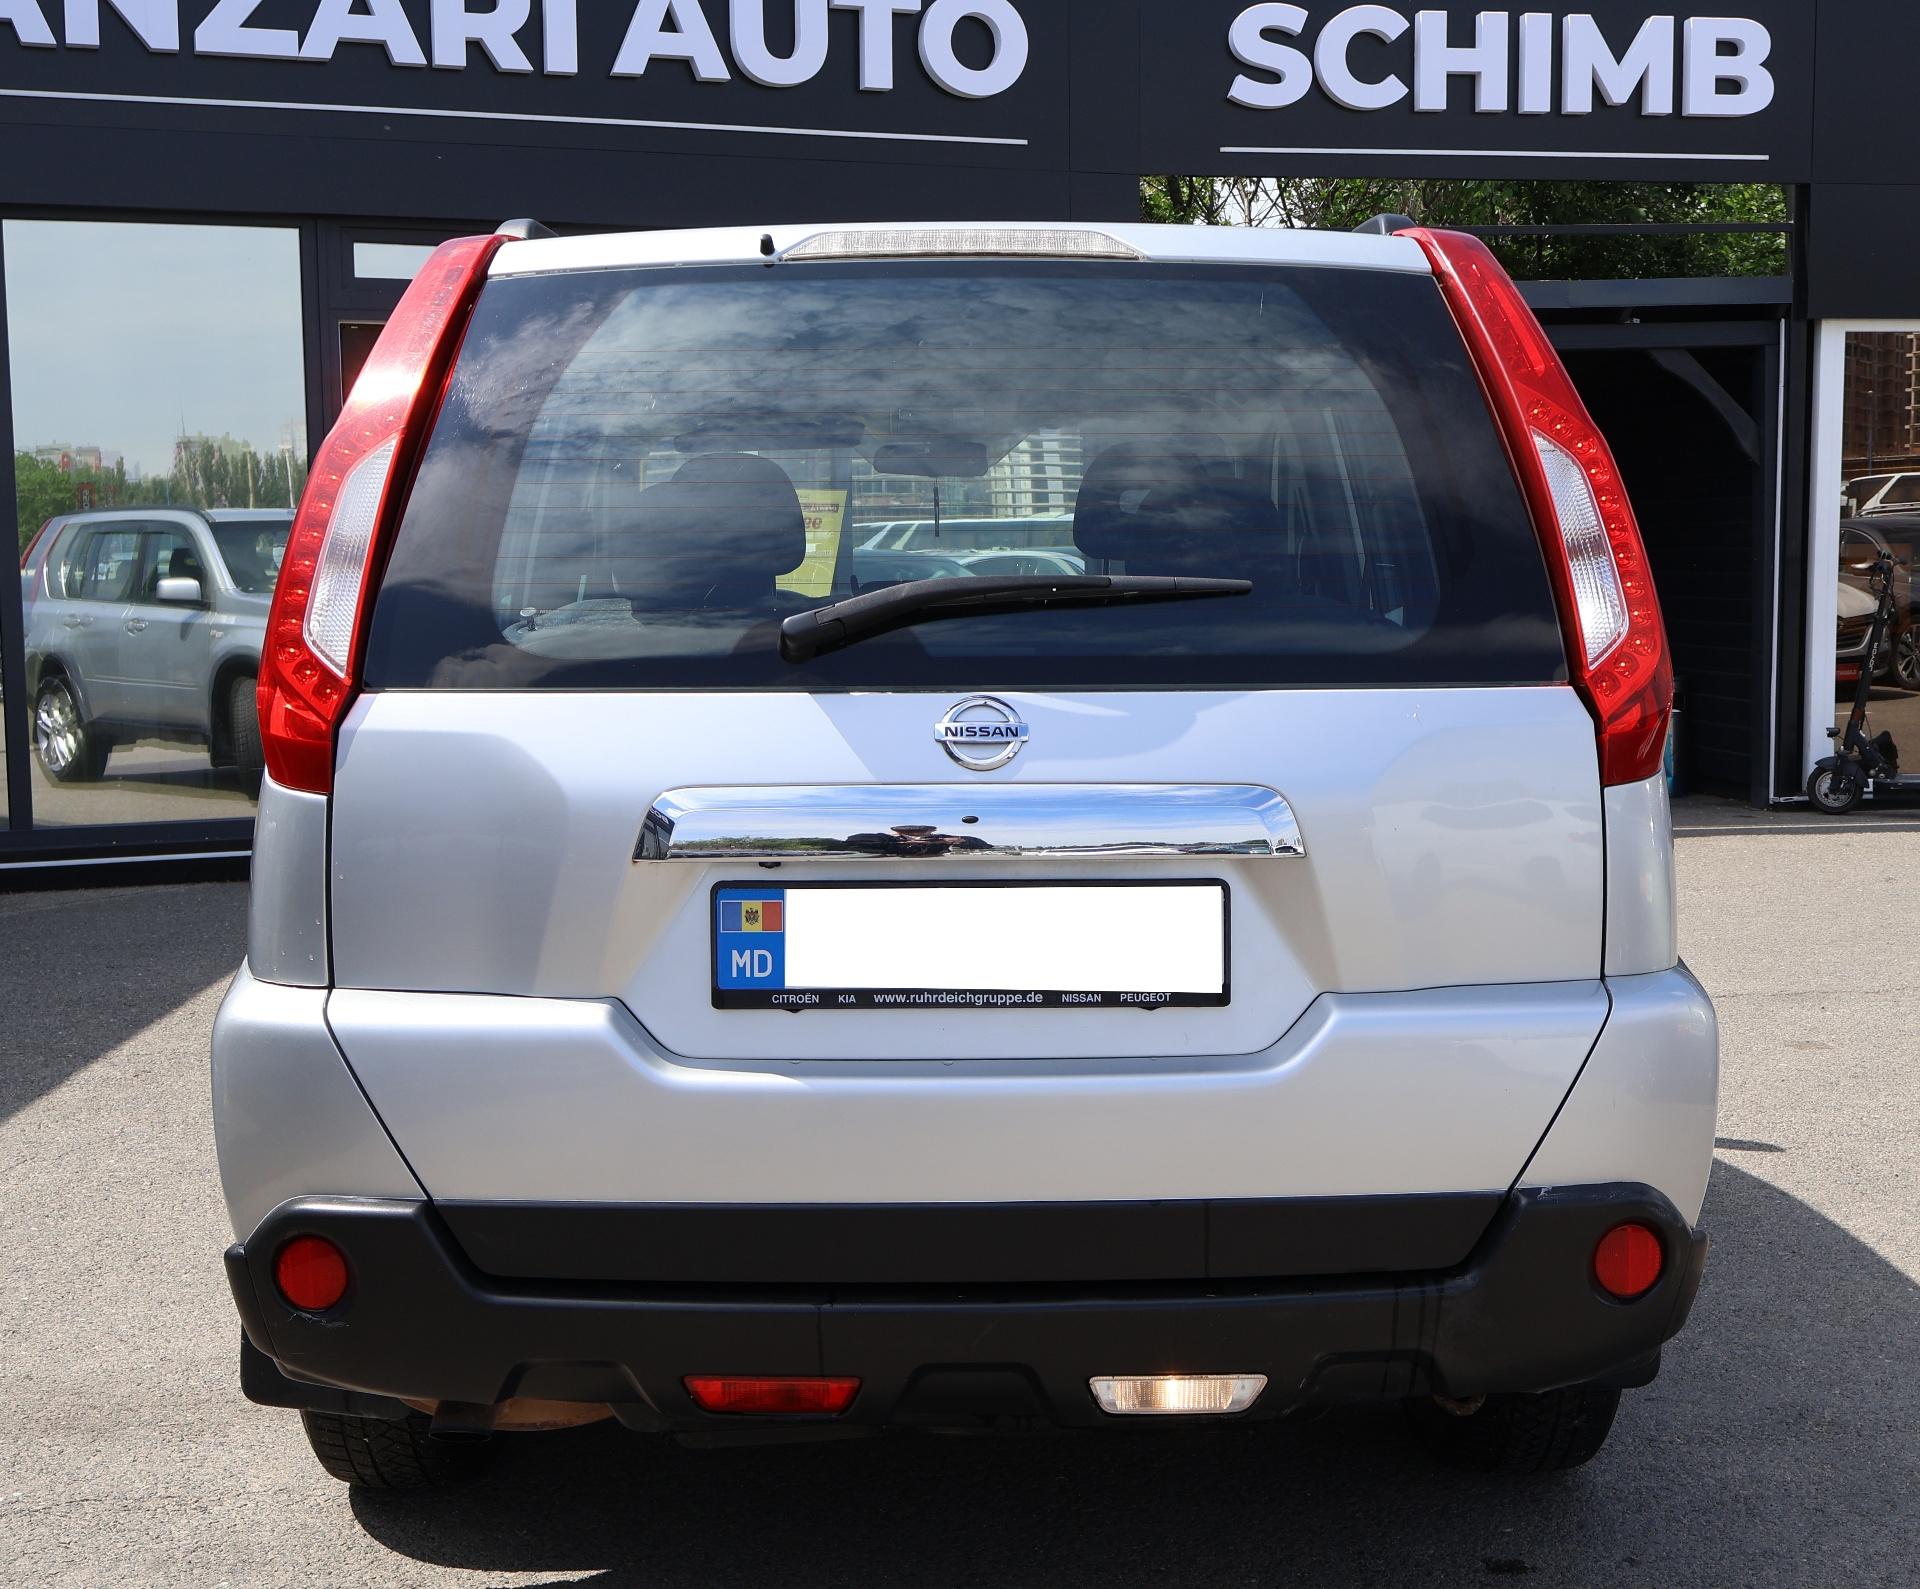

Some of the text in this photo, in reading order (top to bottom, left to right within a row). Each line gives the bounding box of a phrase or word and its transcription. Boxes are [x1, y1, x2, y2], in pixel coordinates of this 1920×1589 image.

[609, 0, 1029, 99] AUTO
[1226, 2, 1775, 117] SCHIMB
[1868, 642, 1879, 672] JOYOR
[944, 726, 1019, 737] NISSAN
[731, 949, 773, 978] MD
[771, 992, 1172, 1006] CITROËN KIA www.ruhrdeichgruppe.de NISSAN PEUGEOT
